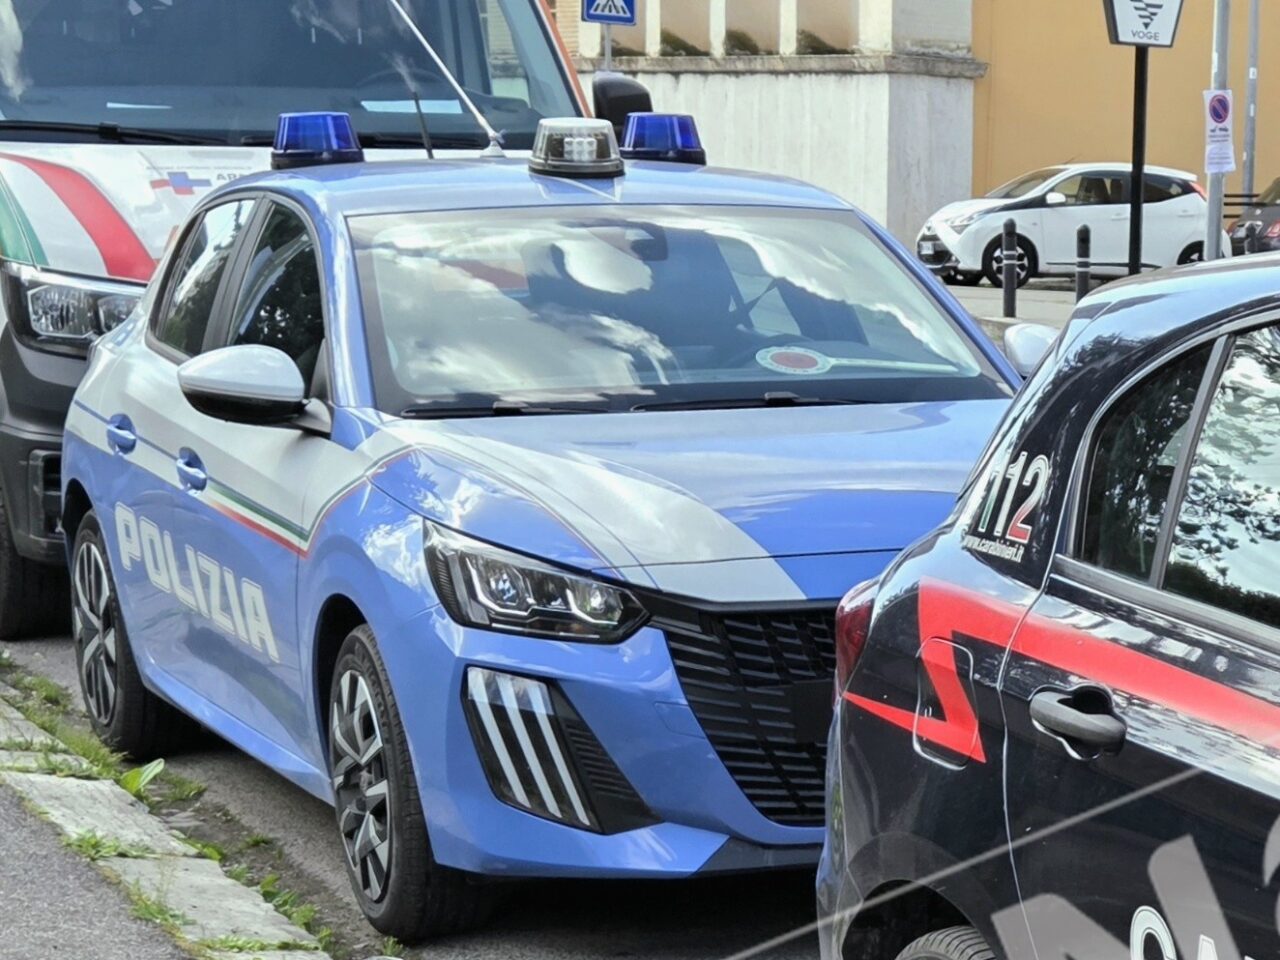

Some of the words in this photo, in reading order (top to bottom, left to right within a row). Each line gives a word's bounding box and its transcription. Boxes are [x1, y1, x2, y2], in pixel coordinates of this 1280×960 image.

[1131, 30, 1160, 41] VOGE
[978, 447, 1049, 544] 112
[115, 502, 279, 663] POLIZIA
